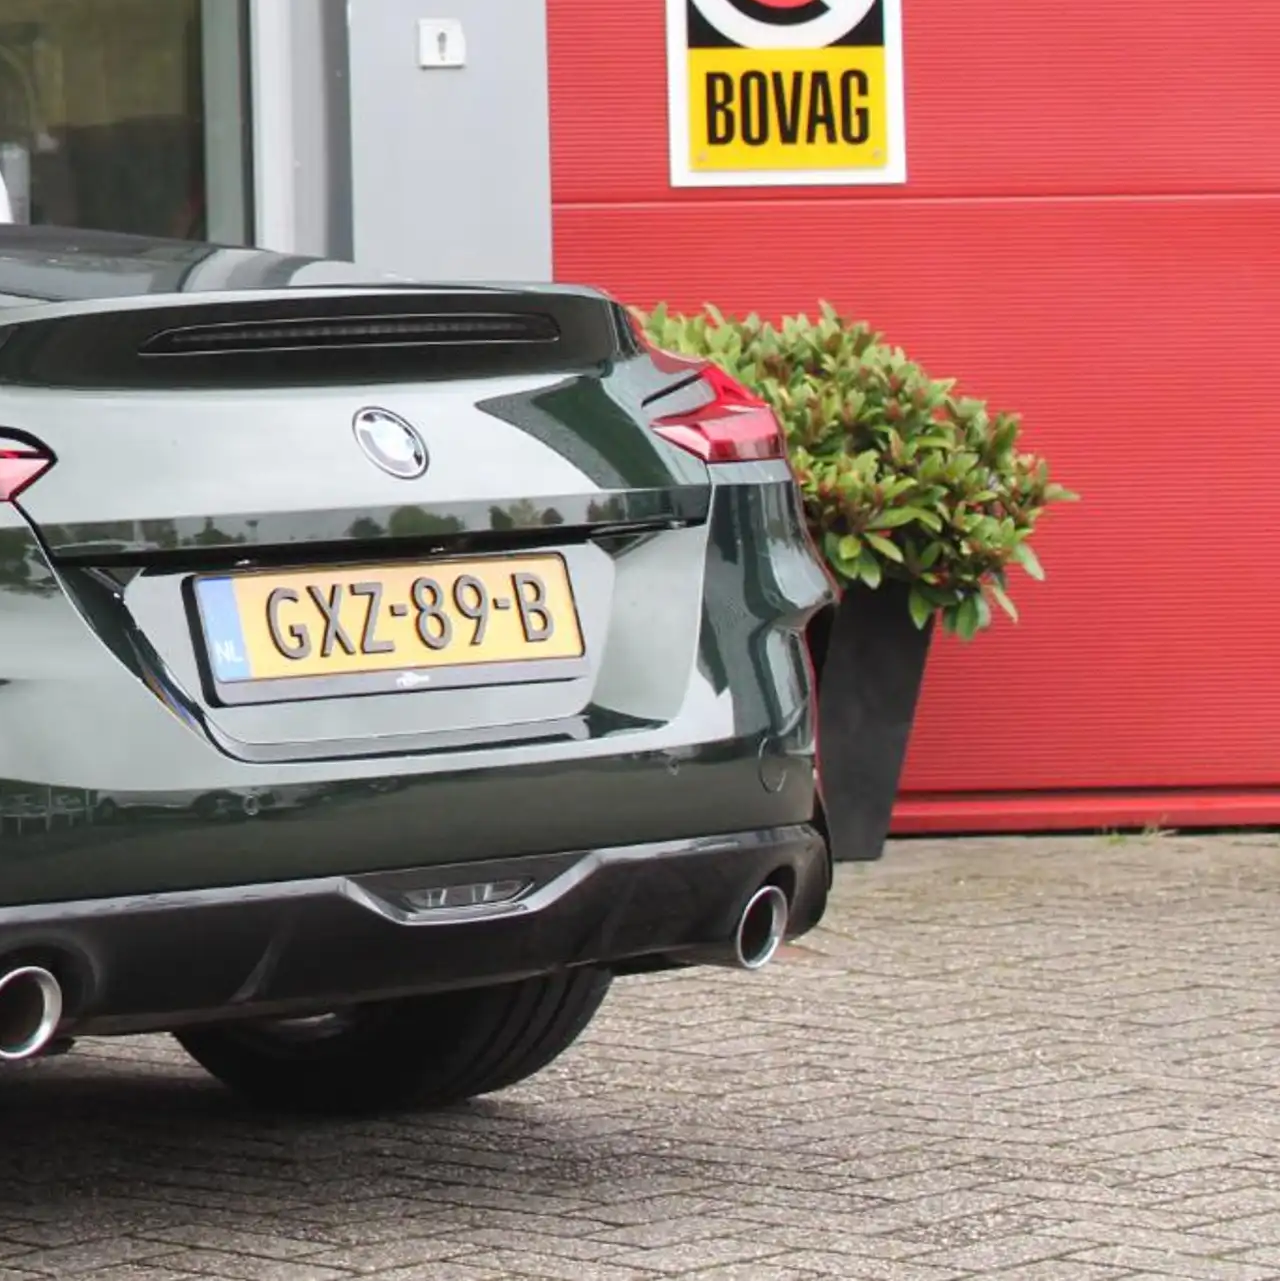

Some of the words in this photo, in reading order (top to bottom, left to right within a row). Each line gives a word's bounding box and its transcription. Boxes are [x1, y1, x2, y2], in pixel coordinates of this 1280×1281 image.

[705, 69, 870, 146] BOVAG
[213, 640, 244, 664] NL
[265, 572, 555, 660] GXZ-89-B
